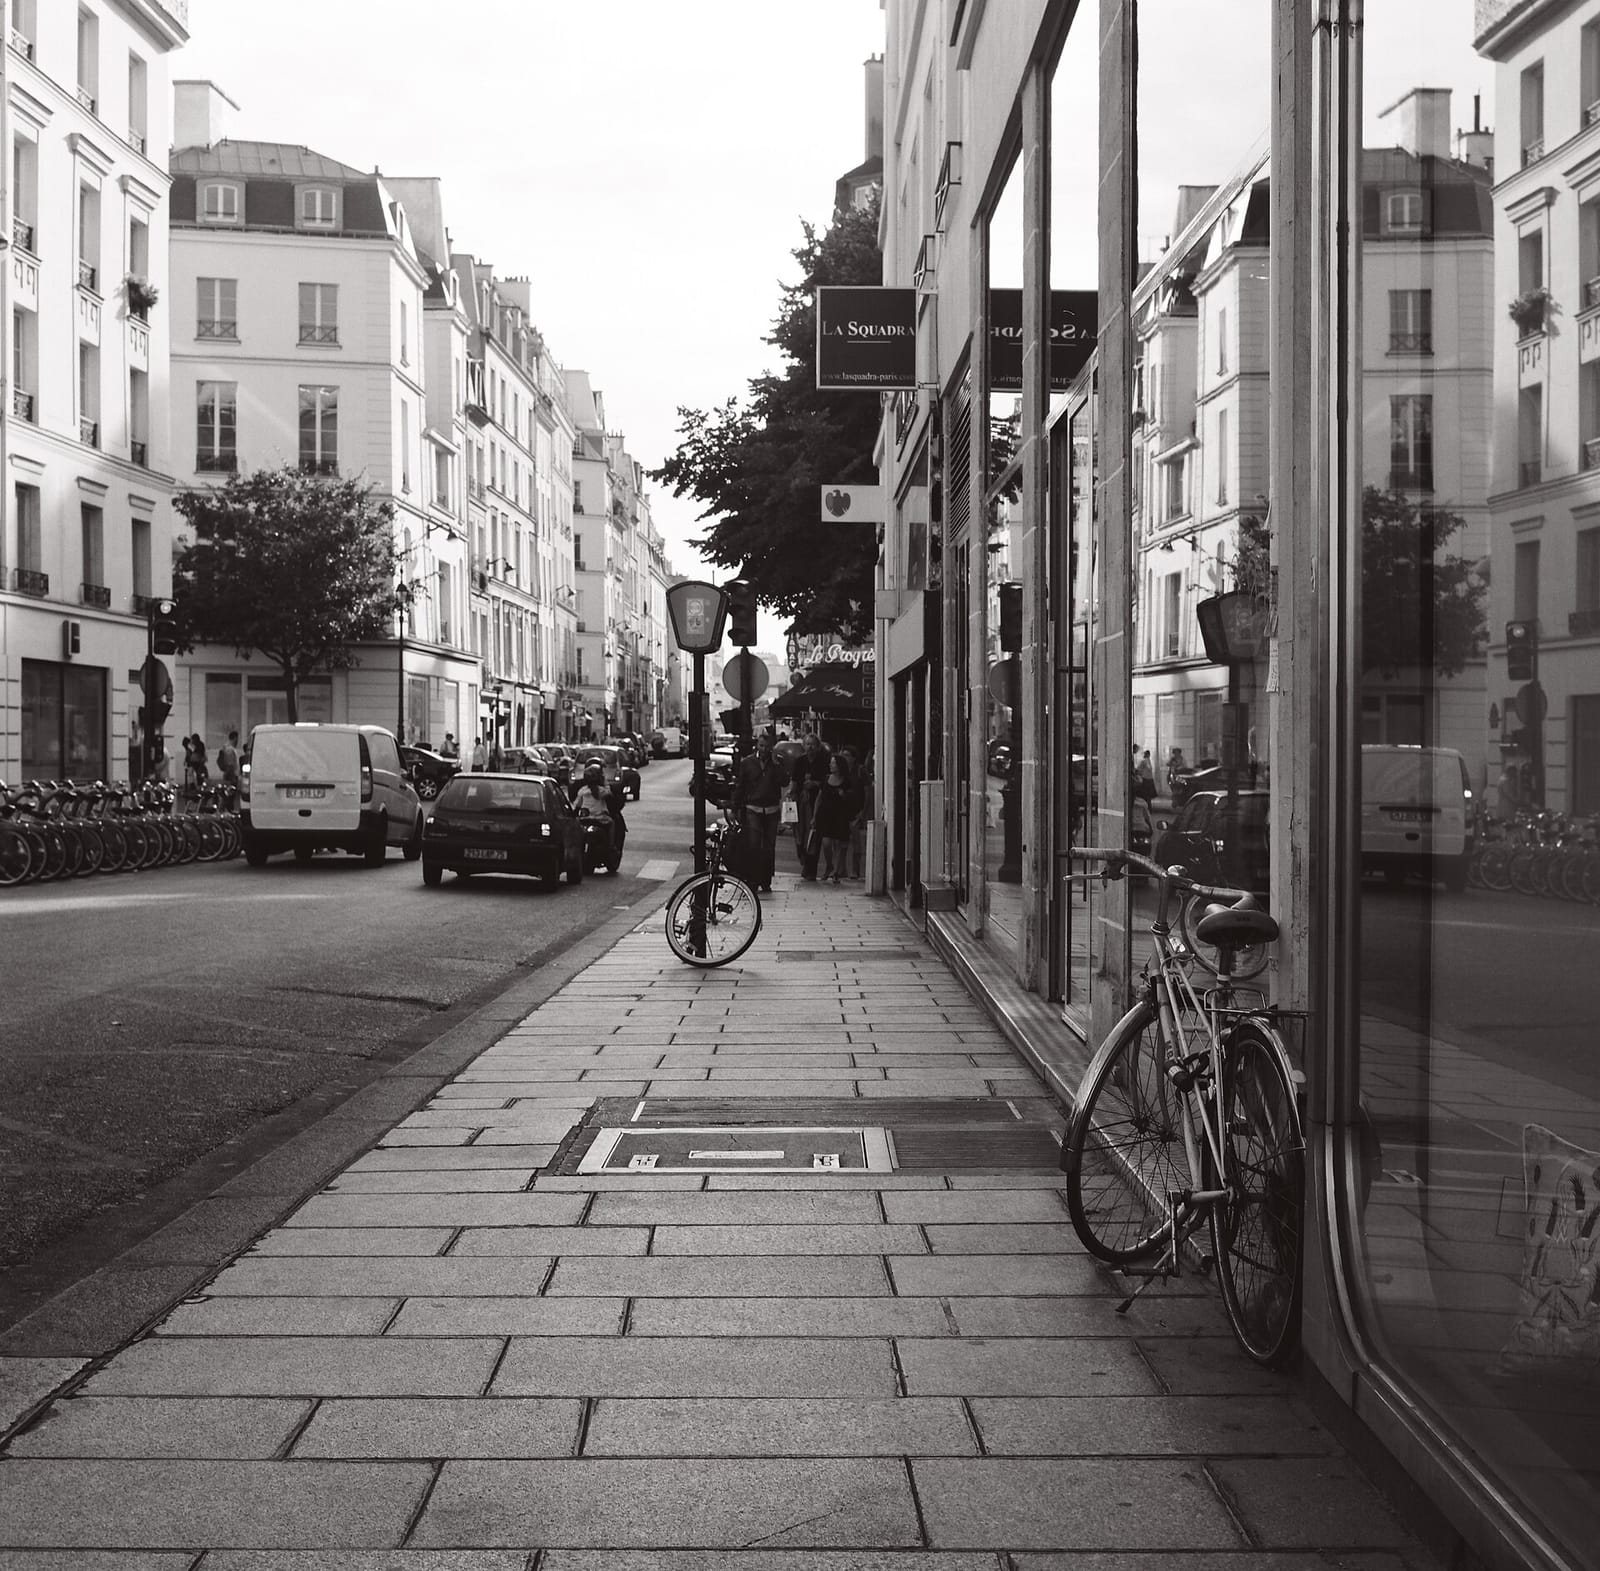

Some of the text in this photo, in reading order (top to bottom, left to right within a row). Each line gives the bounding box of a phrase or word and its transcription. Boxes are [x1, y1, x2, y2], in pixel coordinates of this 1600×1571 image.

[848, 320, 915, 338] SQUADRA
[804, 643, 875, 668] Le Progrè
[800, 711, 829, 720] TAC
